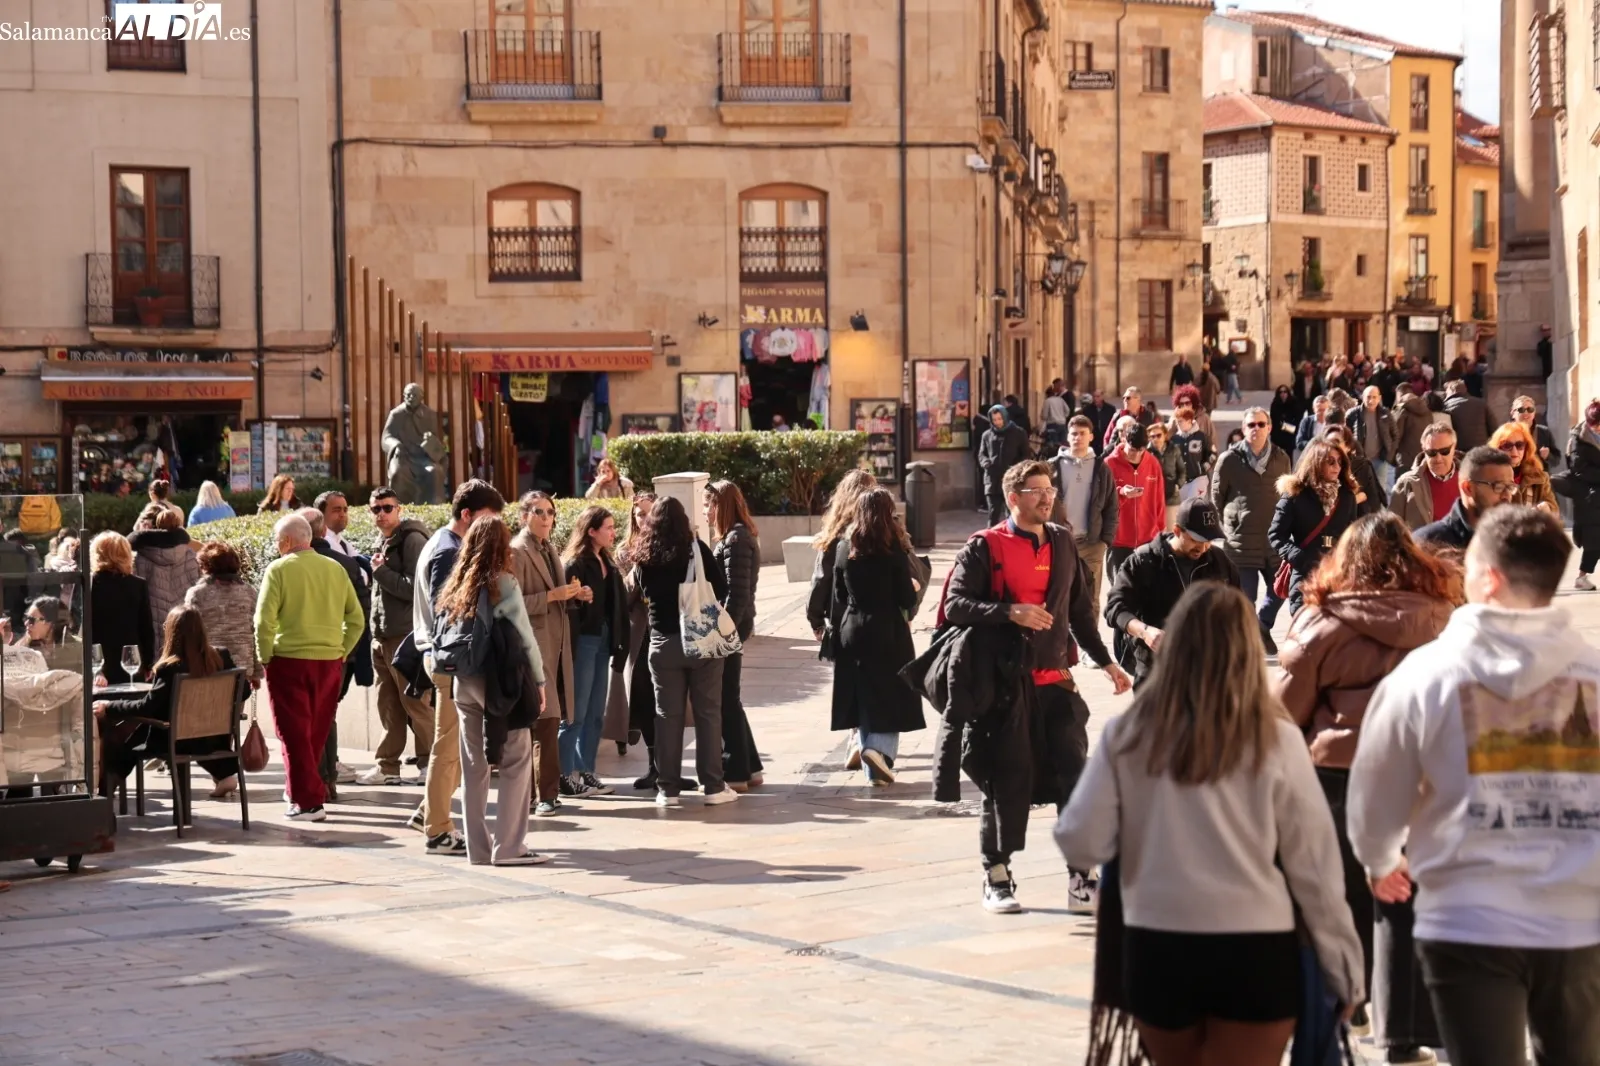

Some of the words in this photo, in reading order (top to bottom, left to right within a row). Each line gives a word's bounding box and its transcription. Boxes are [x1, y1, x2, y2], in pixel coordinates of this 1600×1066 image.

[741, 304, 825, 324] KARMA
[491, 353, 577, 370] KARMA
[580, 354, 649, 367] SOUVENIRS
[68, 384, 130, 398] REGALOS
